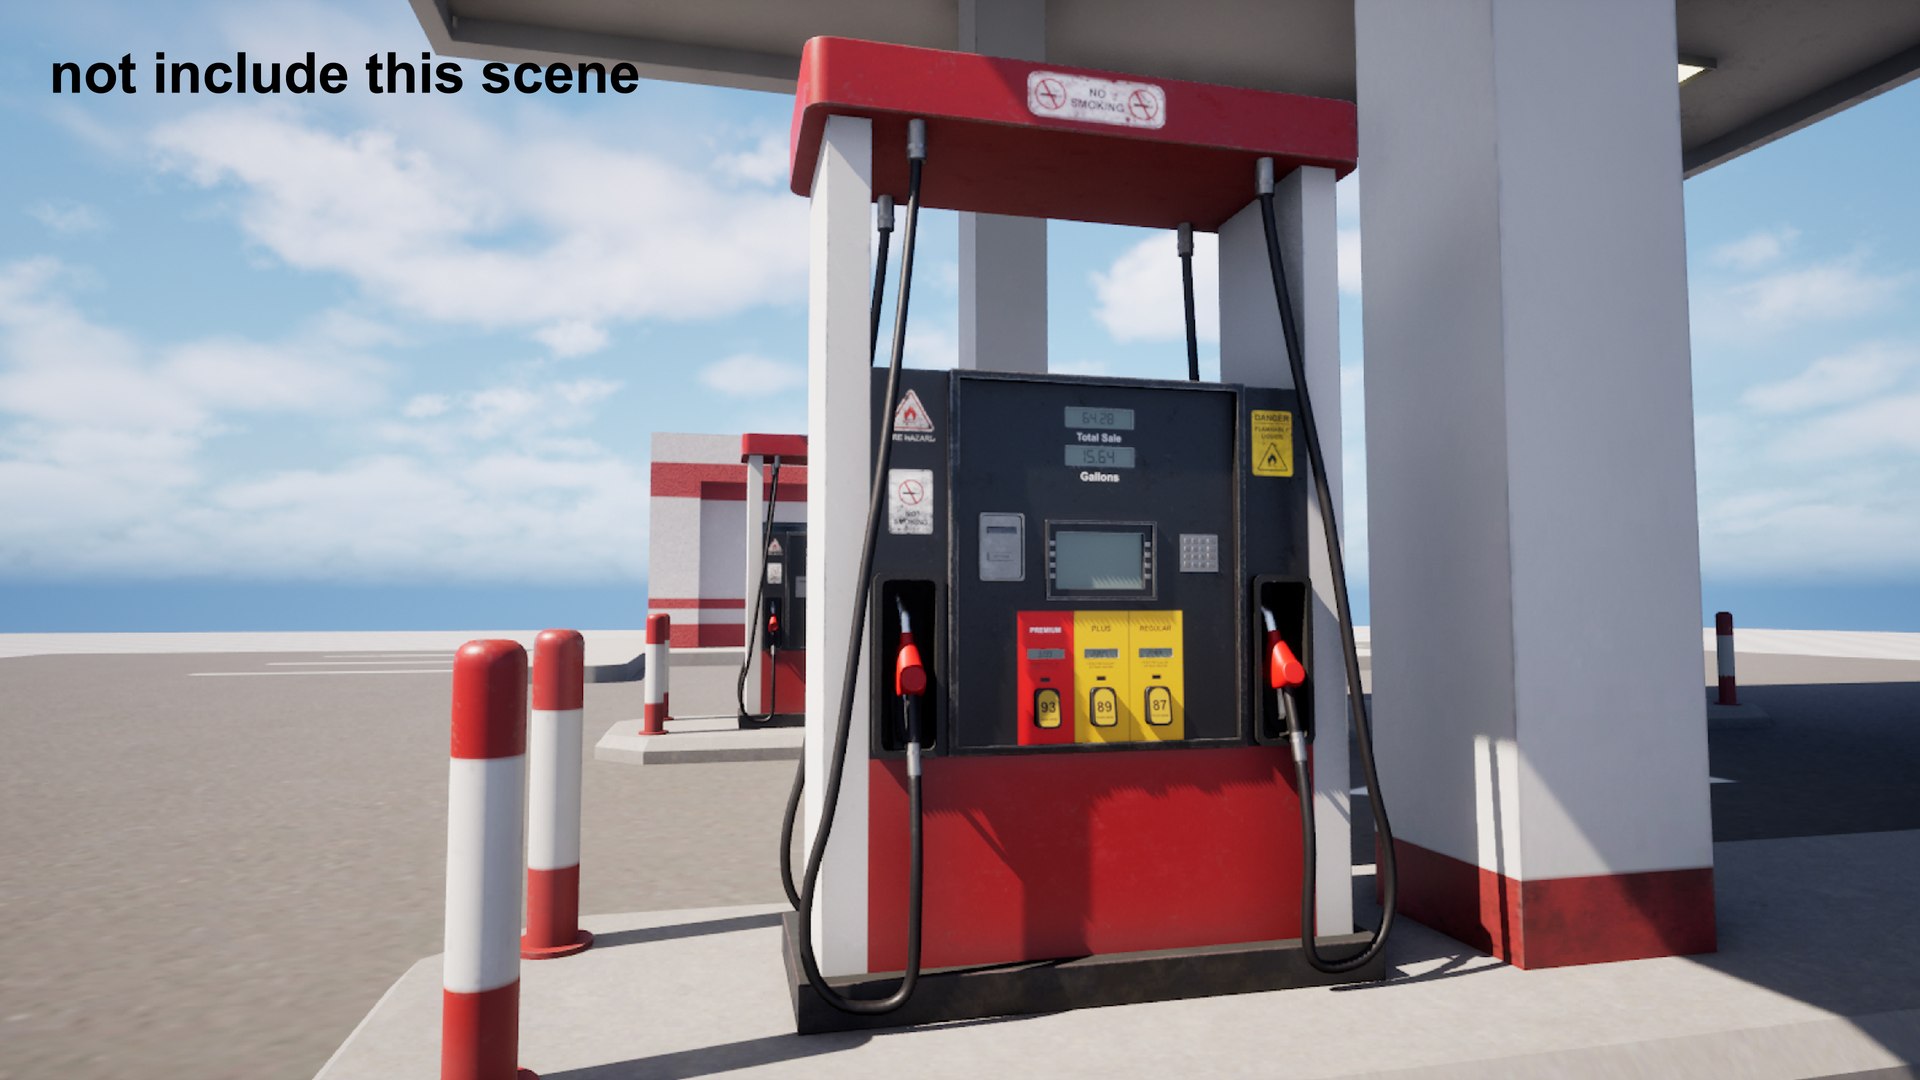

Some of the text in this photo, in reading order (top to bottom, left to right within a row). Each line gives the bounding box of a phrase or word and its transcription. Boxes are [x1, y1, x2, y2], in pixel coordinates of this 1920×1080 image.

[1089, 88, 1106, 98] NO
[1071, 98, 1125, 112] SMOKING
[1254, 413, 1289, 422] DANGER
[1076, 432, 1122, 443] Total Sale
[1083, 449, 1115, 464] 15.64
[1080, 471, 1120, 482] Gallons
[1139, 624, 1172, 632] REGULAR
[1040, 701, 1056, 714] 93
[1097, 701, 1112, 713] 89
[1152, 699, 1167, 711] 87
